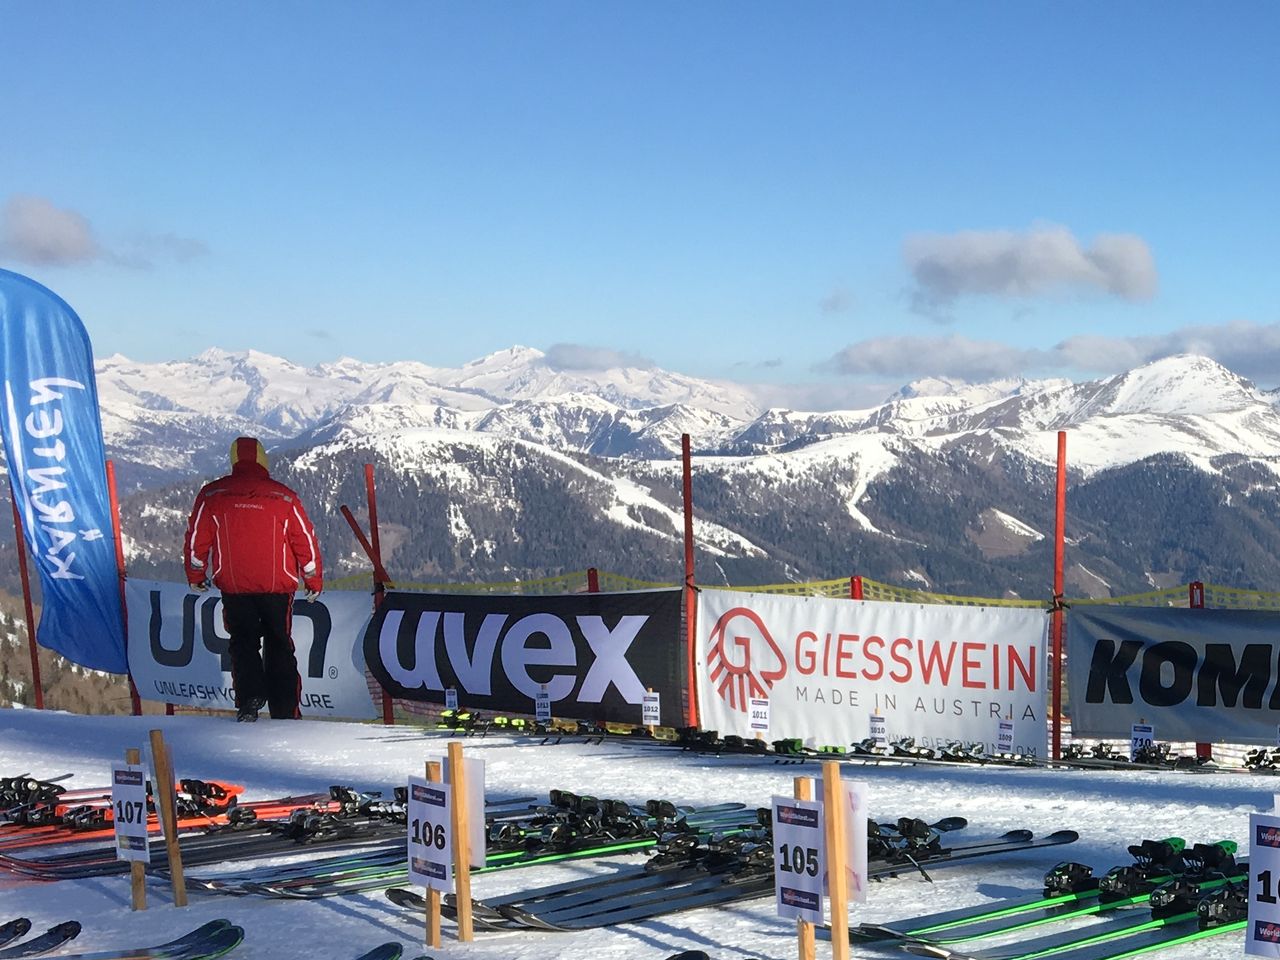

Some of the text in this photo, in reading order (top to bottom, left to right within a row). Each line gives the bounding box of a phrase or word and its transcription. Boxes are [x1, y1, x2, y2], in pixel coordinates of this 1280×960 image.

[379, 609, 650, 704] uvex
[795, 631, 1036, 692] GIESSWEIN
[154, 680, 215, 701] UNLEASH
[796, 686, 1036, 721] MADE IN AUSTRIA
[643, 705, 658, 713] 1012
[752, 710, 768, 720] 1011
[116, 800, 143, 824] 107
[411, 818, 446, 850] 106
[779, 843, 819, 877] 105
